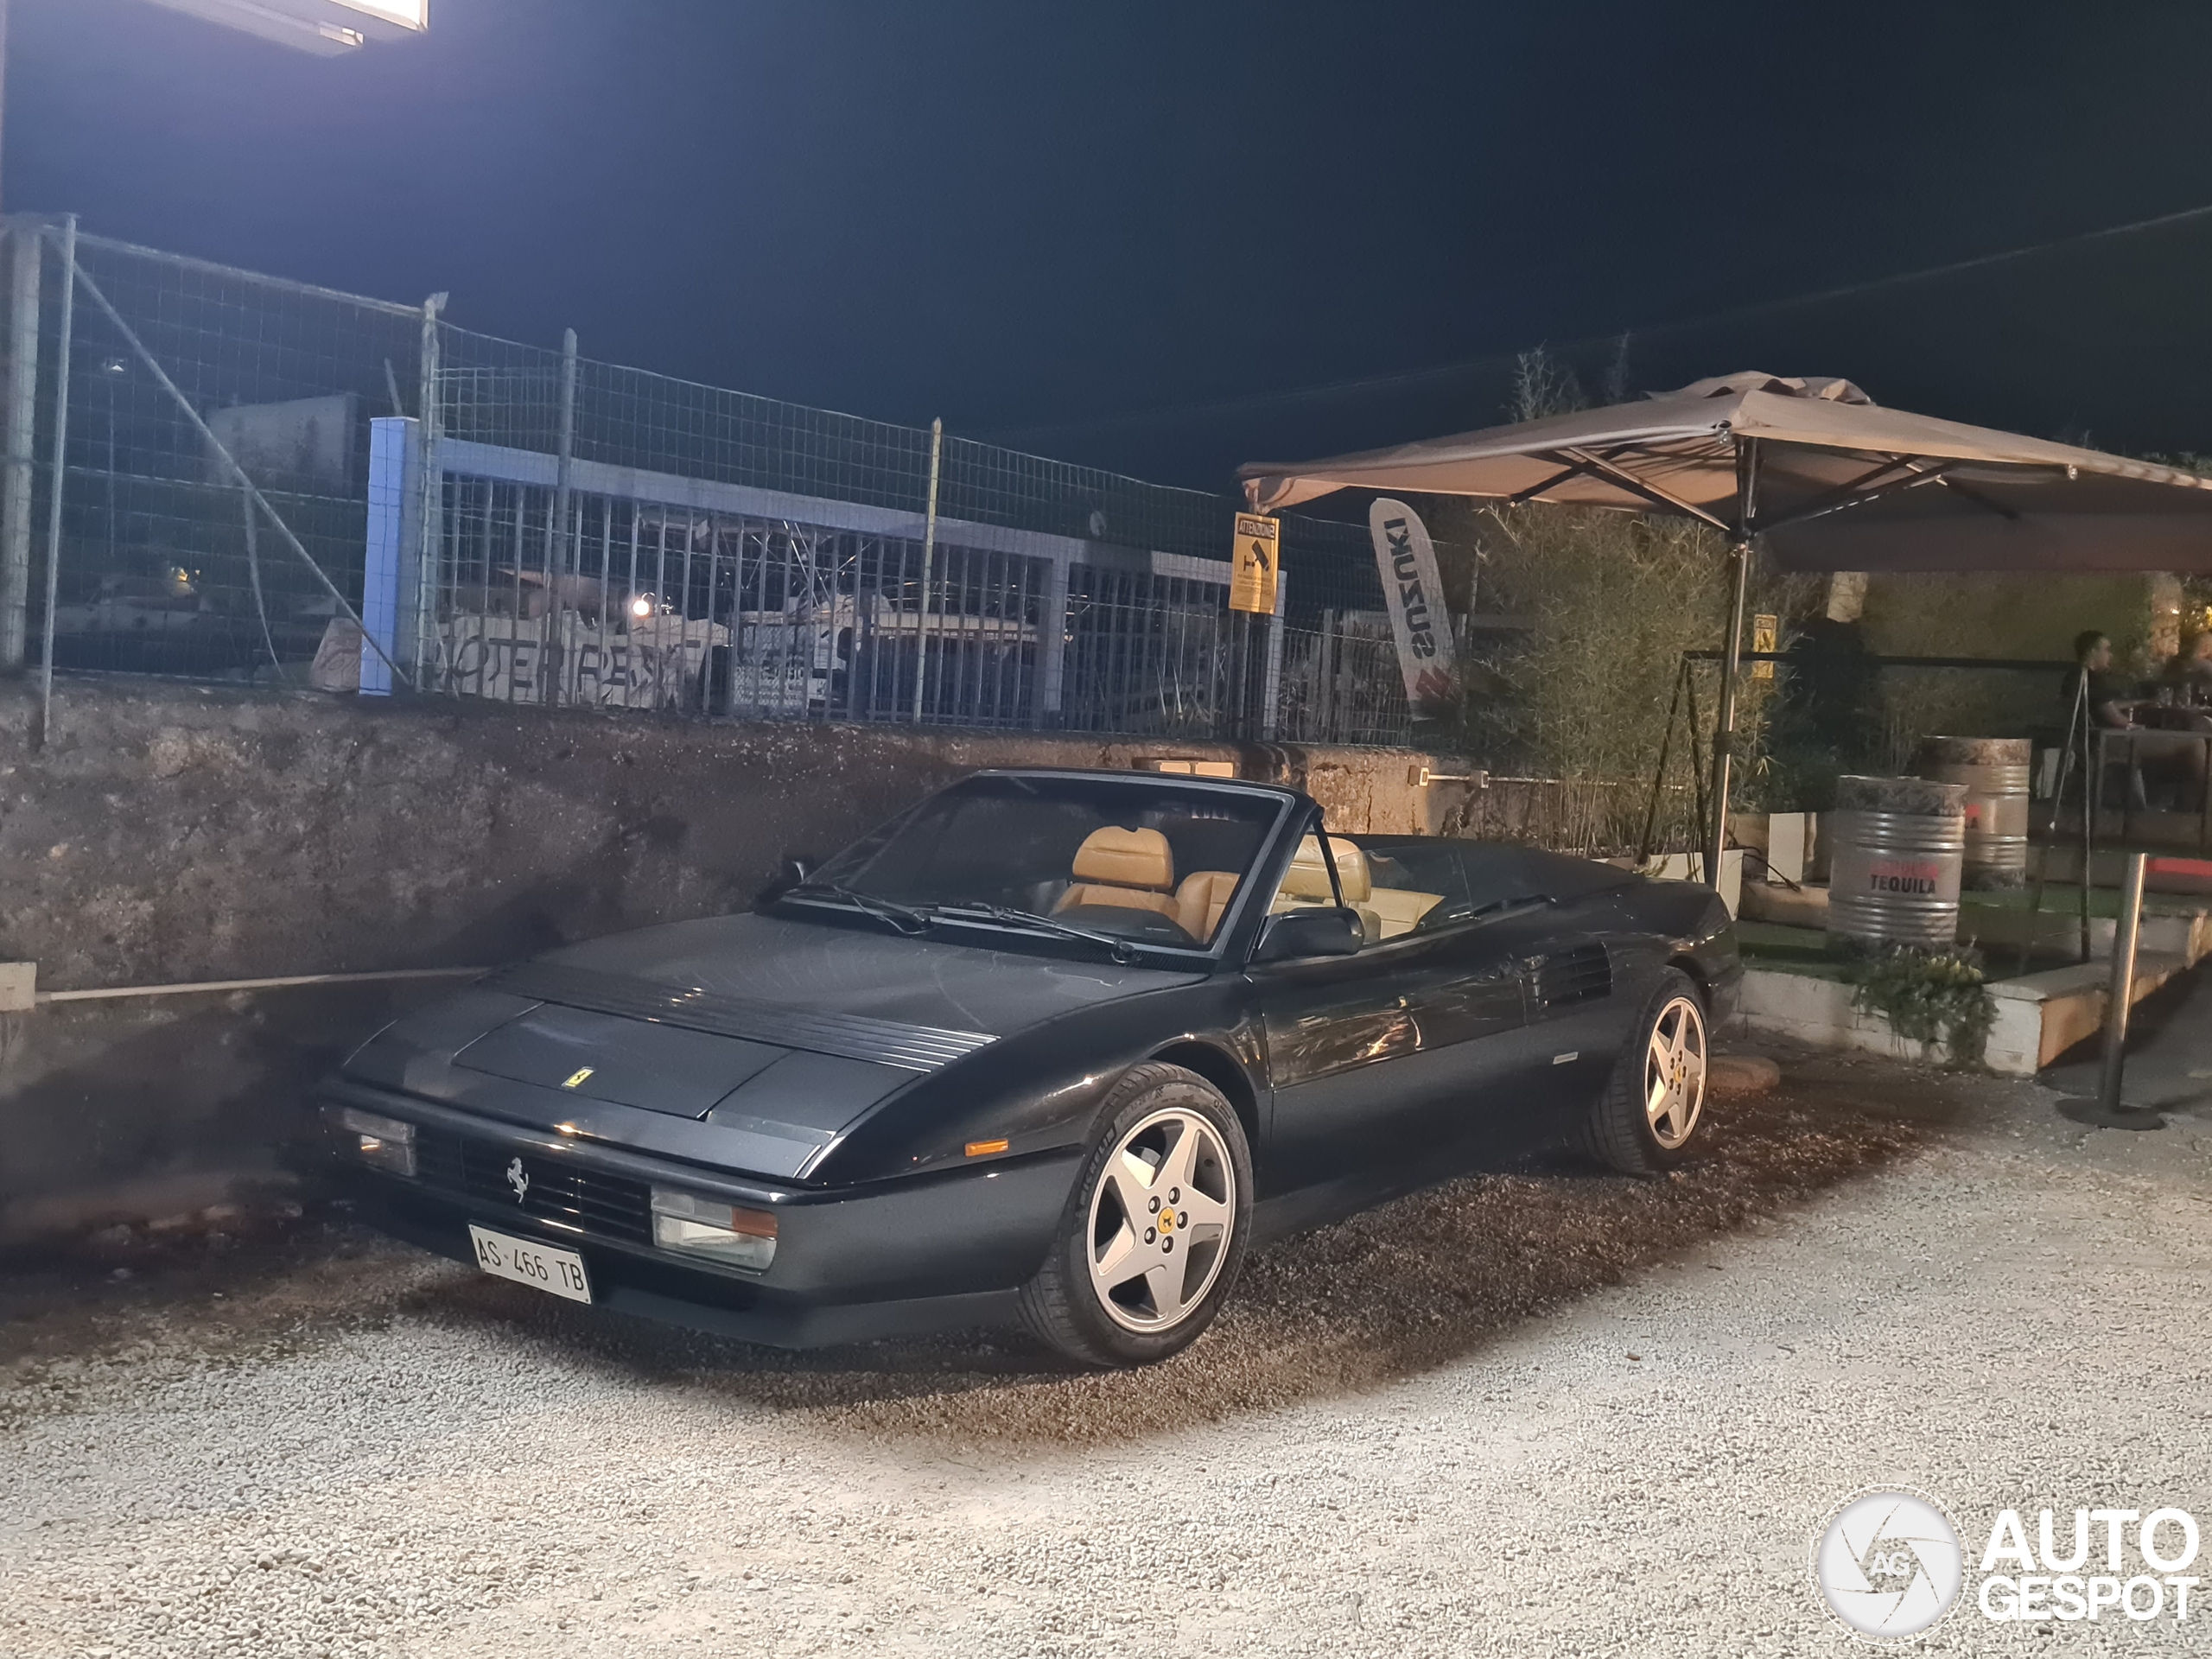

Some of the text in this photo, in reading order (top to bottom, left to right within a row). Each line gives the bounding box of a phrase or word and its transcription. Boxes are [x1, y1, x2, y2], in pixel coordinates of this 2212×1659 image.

[1870, 874, 1936, 894] TEQUILA
[477, 1236, 585, 1292] AS 466 TB
